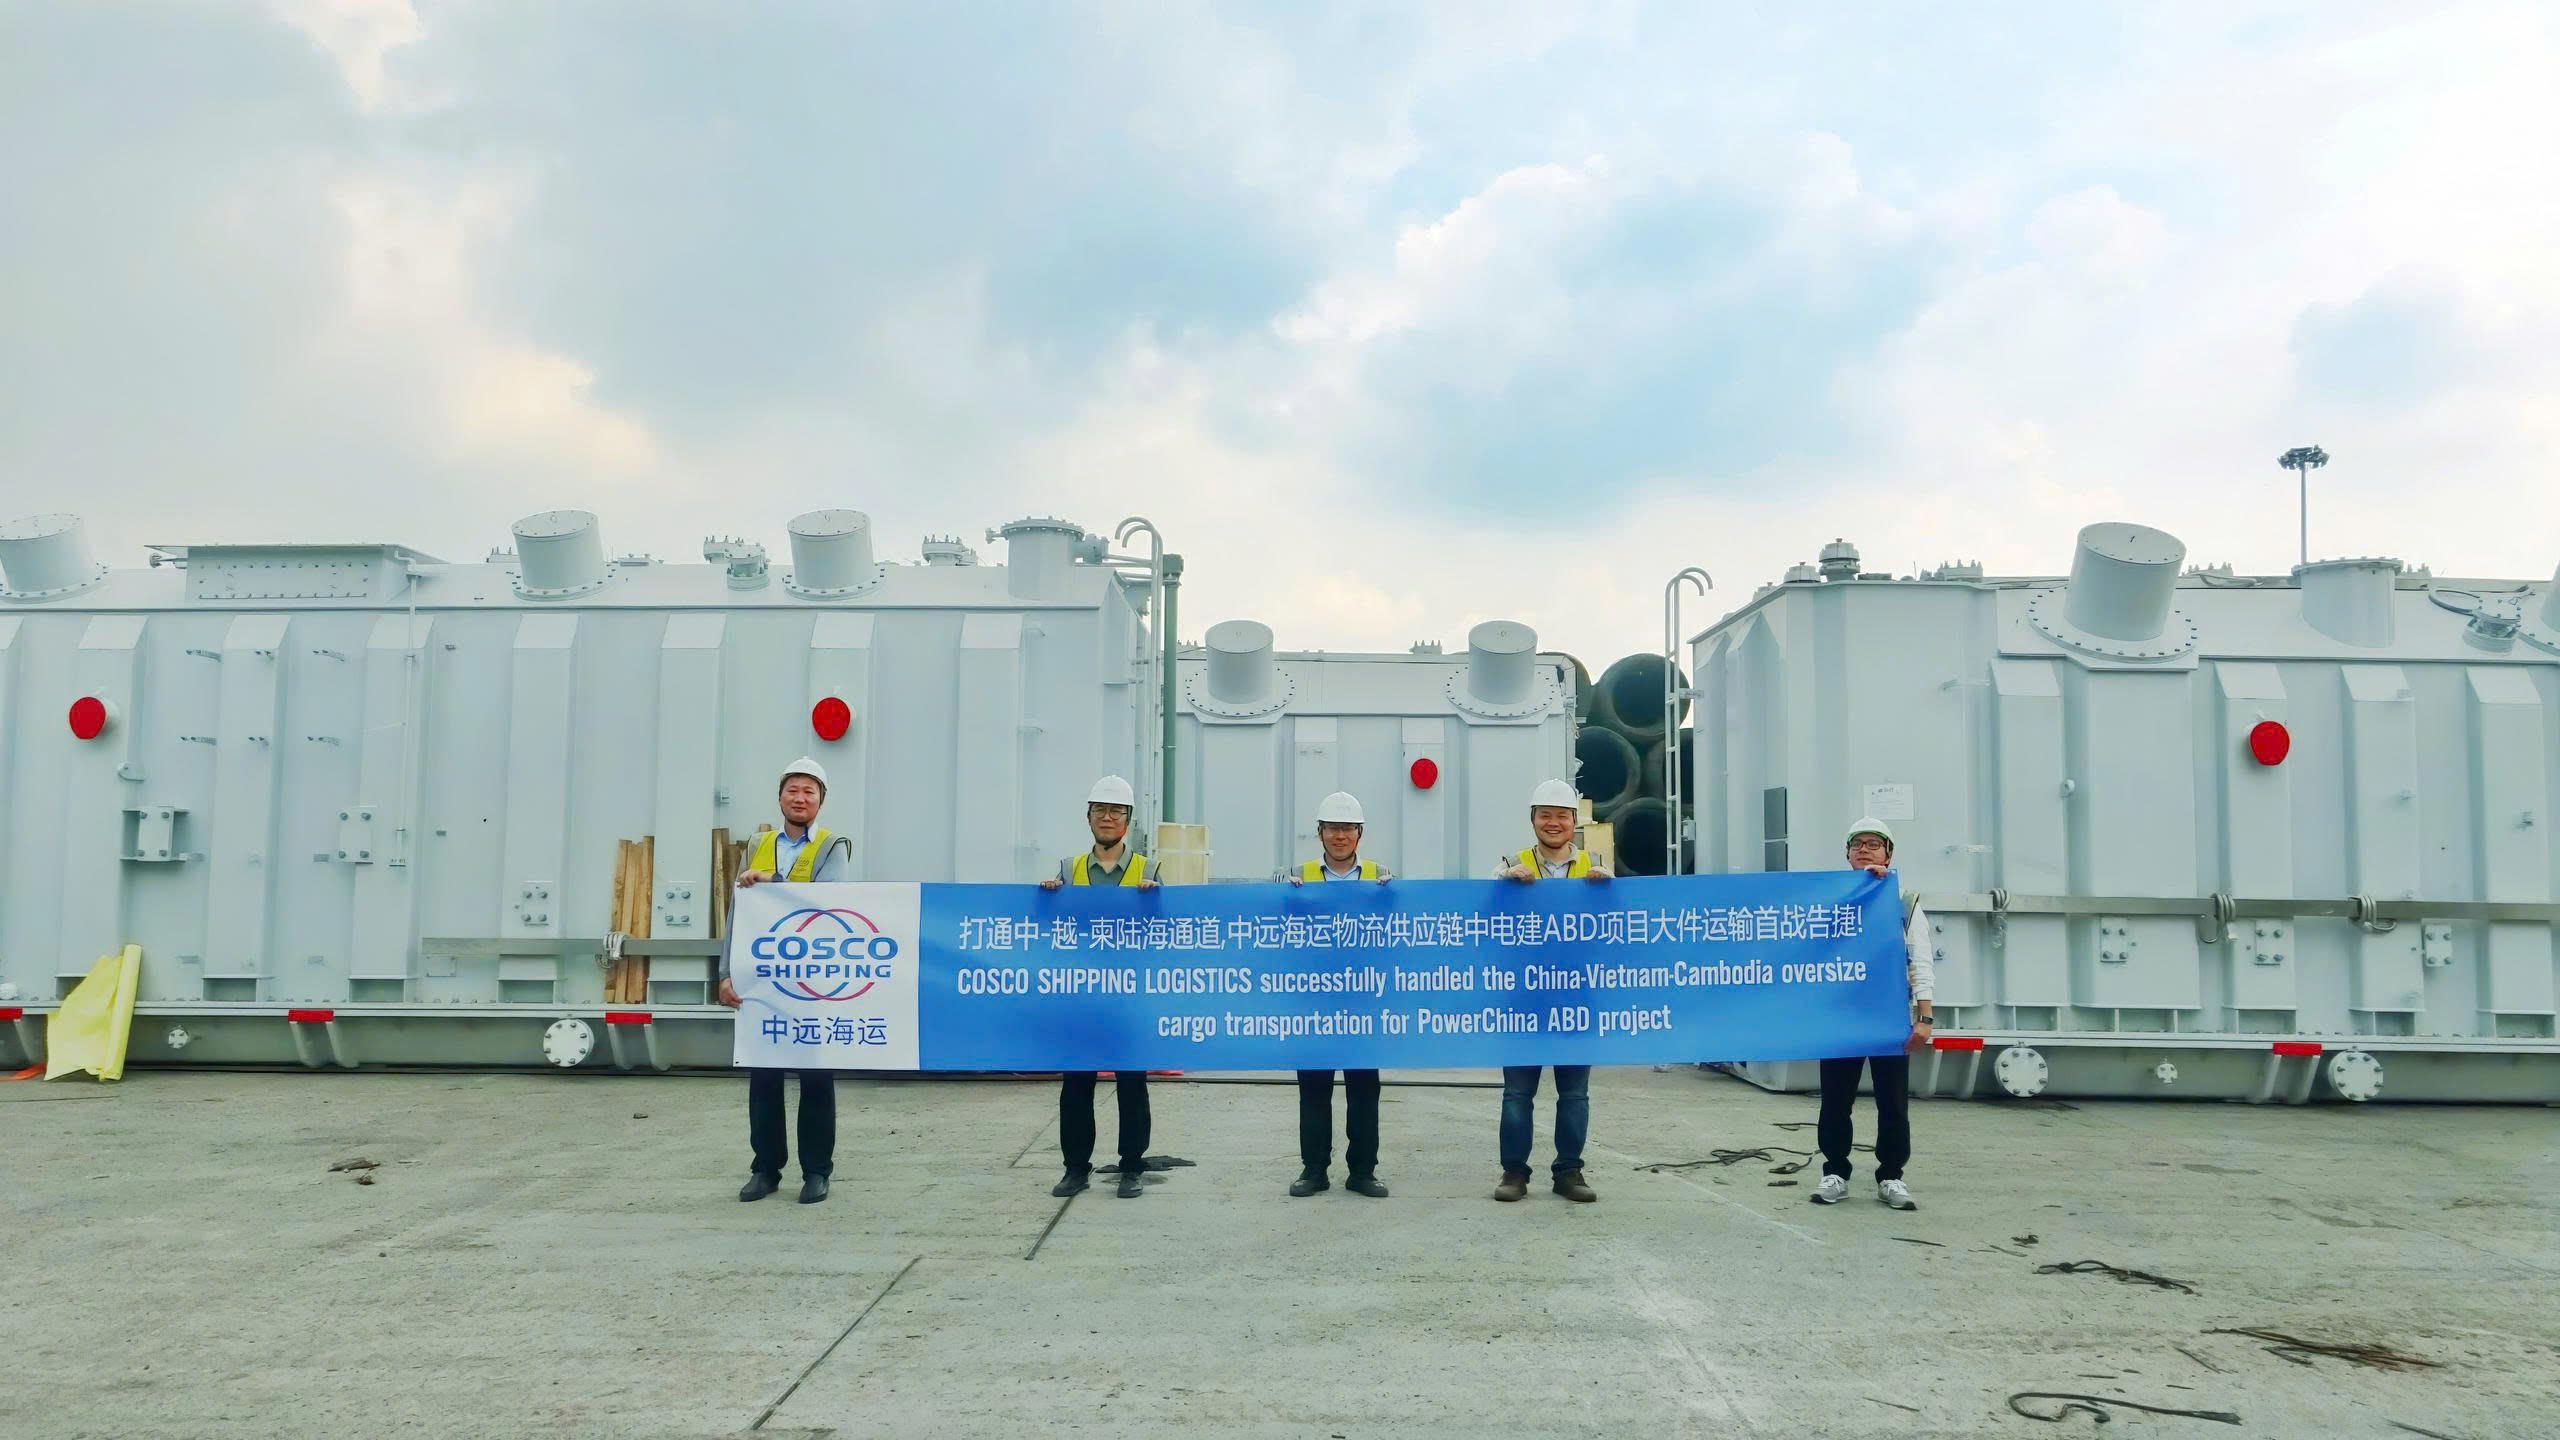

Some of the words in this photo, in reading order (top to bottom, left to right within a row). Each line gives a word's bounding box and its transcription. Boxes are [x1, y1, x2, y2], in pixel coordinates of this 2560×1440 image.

[751, 936, 899, 961] COSCO
[756, 964, 892, 979] SHIPPING
[957, 967, 1029, 995] COSCO
[1037, 968, 1137, 994] SHIPPING
[1145, 967, 1252, 994] LOGISTICS
[1260, 966, 1387, 998] successfully
[1394, 965, 1474, 992] handled
[1482, 965, 1516, 991] the
[1524, 959, 1773, 991] China-Vietnam-Cambodia
[1781, 956, 1867, 984] oversize
[762, 1015, 888, 1045] 中远海运
[1158, 1015, 1217, 1043] cargo
[1224, 1009, 1373, 1041] transportation
[1380, 1008, 1410, 1035] for
[1418, 1007, 1538, 1034] PowerChina
[1547, 1006, 1590, 1032] ABD
[1598, 1004, 1672, 1037] project
